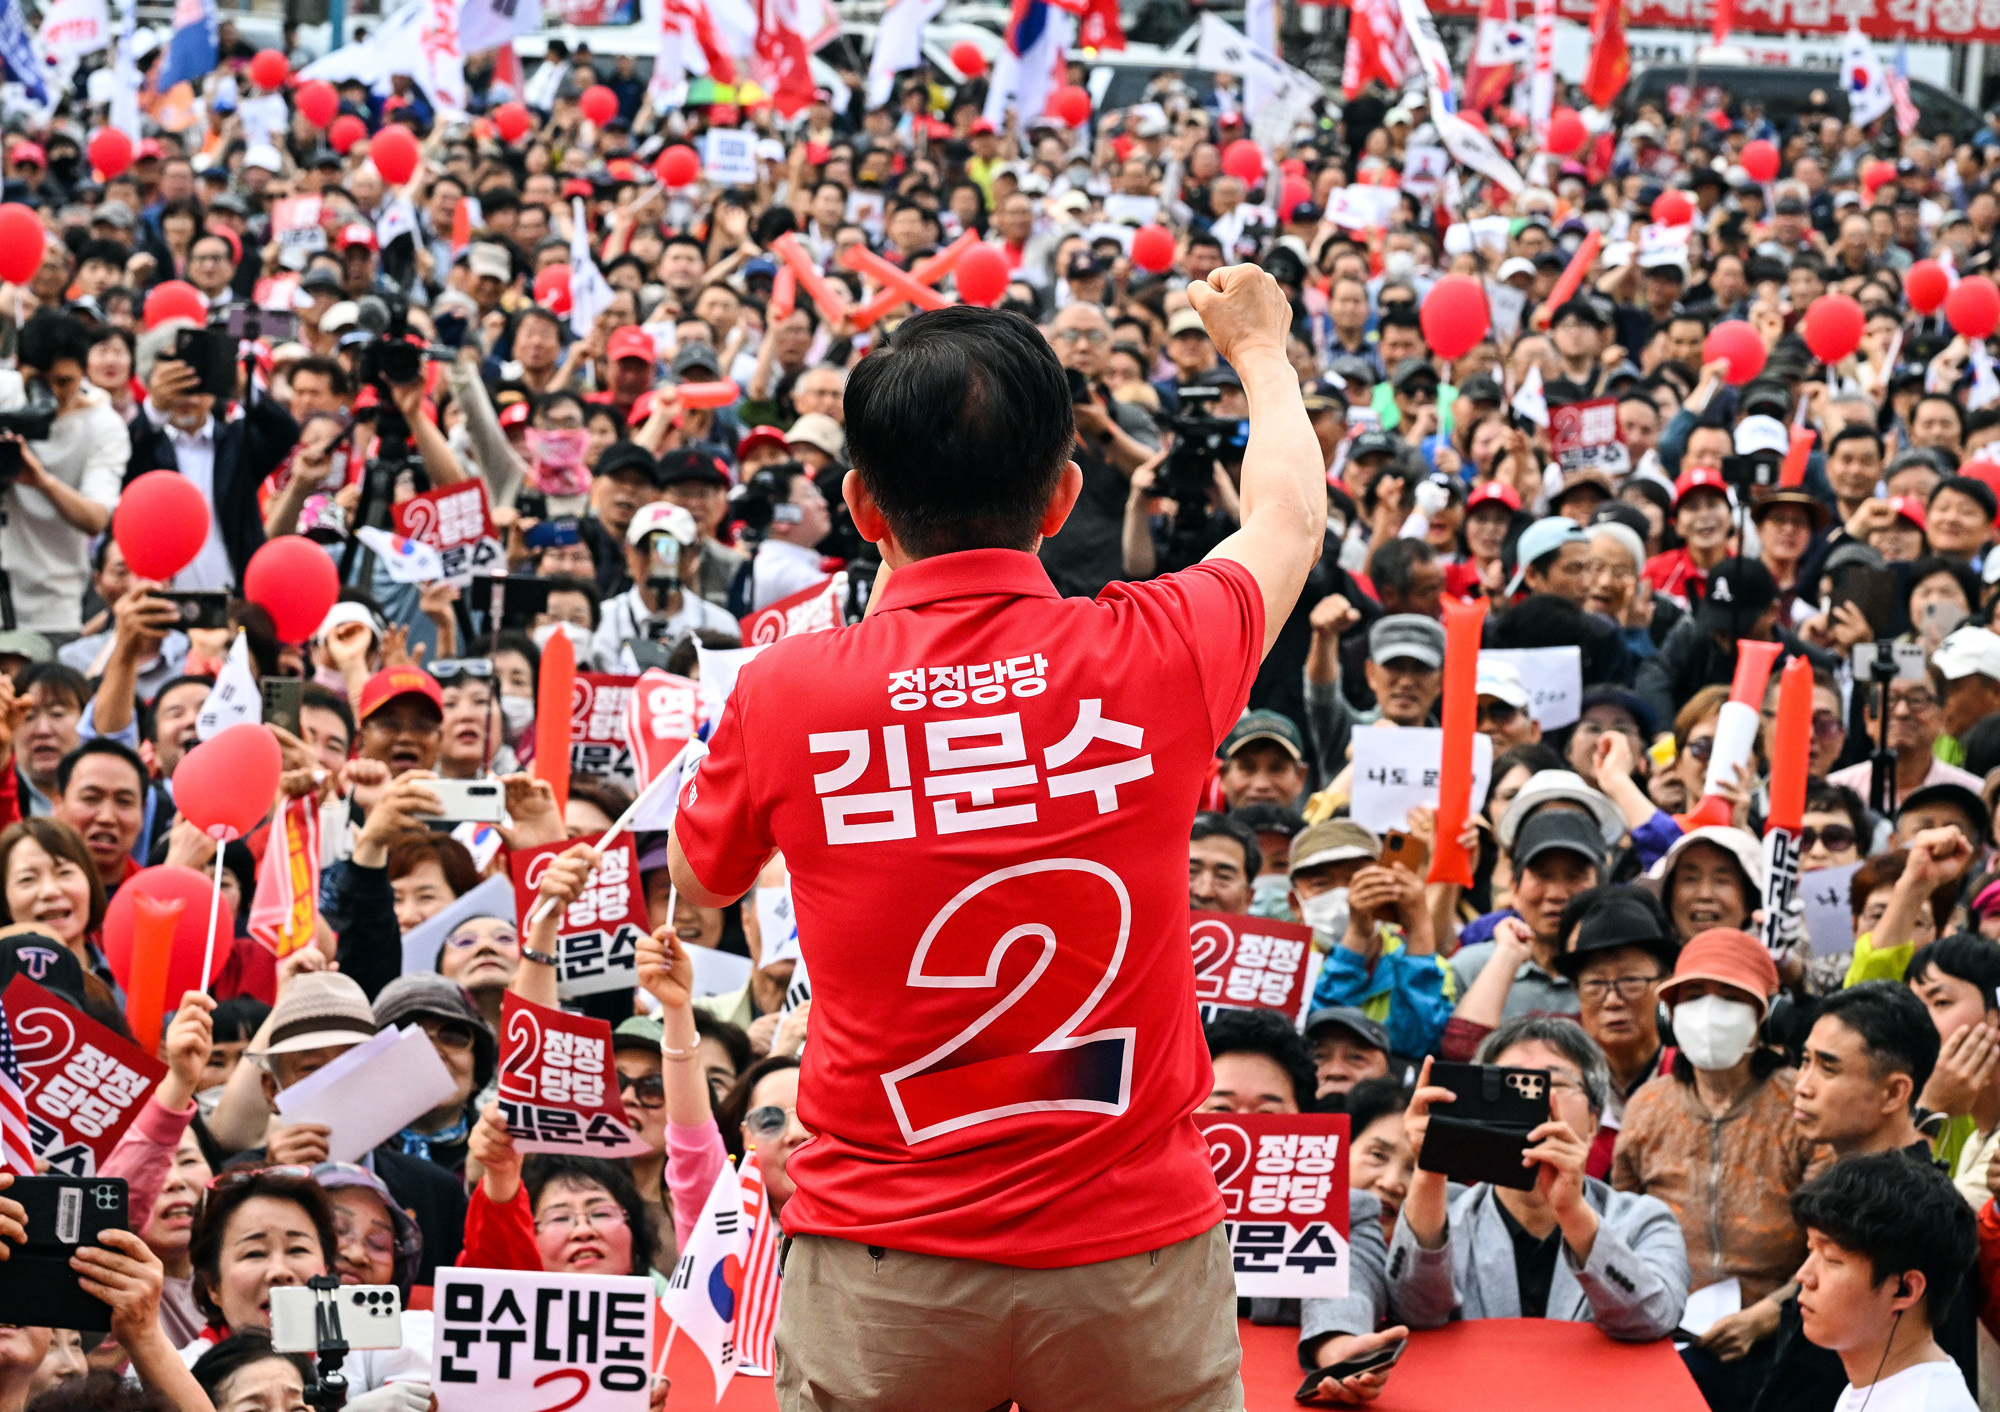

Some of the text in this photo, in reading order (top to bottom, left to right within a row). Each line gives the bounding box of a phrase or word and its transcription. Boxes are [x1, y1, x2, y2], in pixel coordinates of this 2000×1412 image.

[888, 653, 1049, 711] 정정당당
[808, 698, 1154, 845] 김문수
[16, 946, 59, 980] T
[556, 927, 636, 982] 문수
[1190, 919, 1235, 999] 2
[1235, 932, 1305, 974] 정정
[880, 857, 1136, 1146] 2
[1225, 965, 1295, 1007] 당당
[15, 1007, 76, 1098] 2
[64, 1042, 152, 1109] 정정
[499, 1008, 541, 1099] 2
[542, 1028, 606, 1074] 정정
[35, 1073, 122, 1139] 당당
[540, 1065, 606, 1107] 당당
[498, 1100, 631, 1147] 김문수
[1202, 1122, 1252, 1215] 2
[1256, 1133, 1340, 1175] 정정
[1248, 1174, 1333, 1215] 당당
[1225, 1222, 1338, 1275] 문수
[440, 1282, 648, 1393] 문수대통
